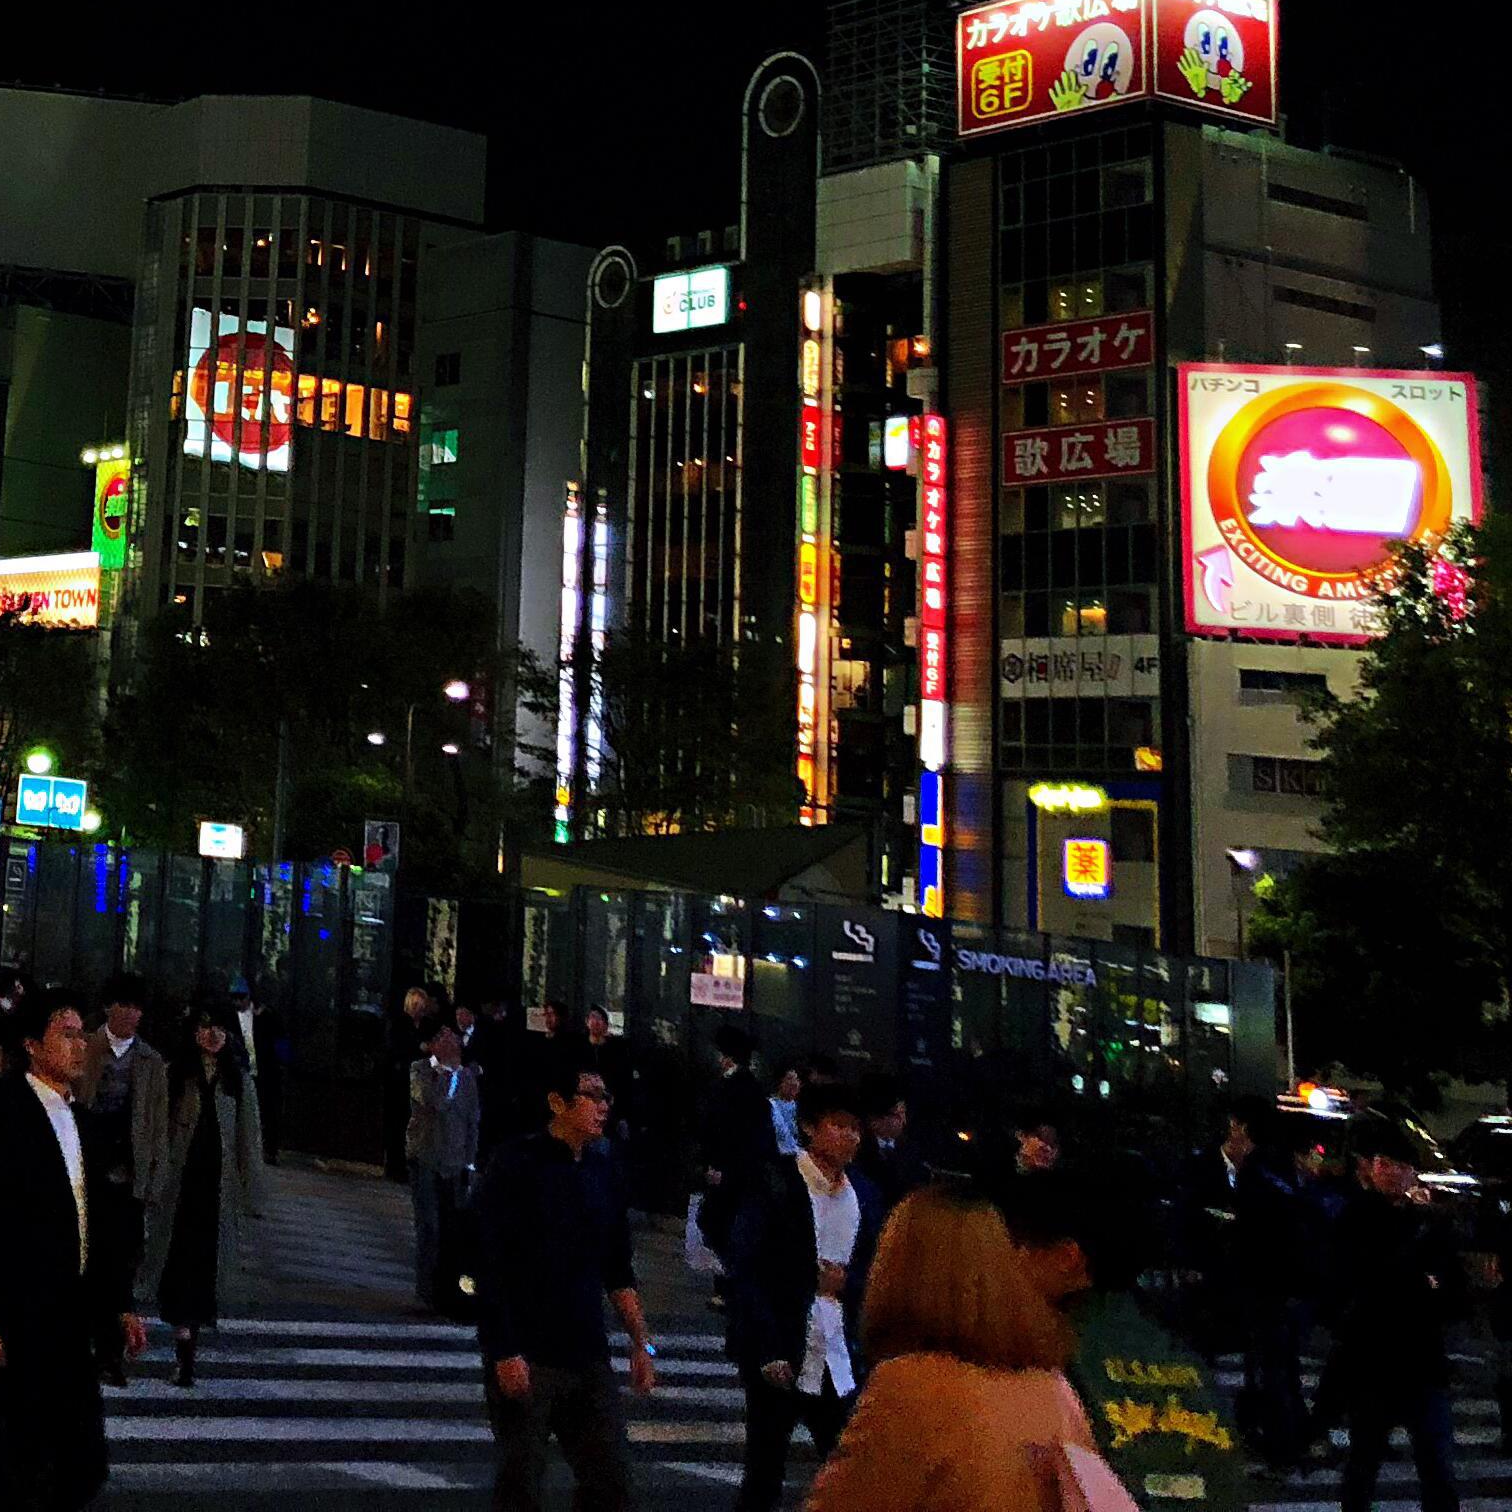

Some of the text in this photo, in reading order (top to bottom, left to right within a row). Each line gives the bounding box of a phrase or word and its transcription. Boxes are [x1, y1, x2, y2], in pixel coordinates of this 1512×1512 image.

[977, 56, 1027, 89] 受付
[978, 83, 1024, 113] 6F
[679, 294, 716, 313] CLUB
[1010, 323, 1145, 375] カラオケ
[1190, 376, 1260, 394] パチンコ
[1392, 383, 1463, 402] スロット
[1014, 426, 1141, 477] 歌広場
[1219, 518, 1308, 593] EXCITING
[54, 589, 97, 609] TOWN
[1230, 601, 1335, 628] ビル裏側
[1135, 656, 1159, 674] 4F
[956, 950, 1097, 987] SMOKING AREA
